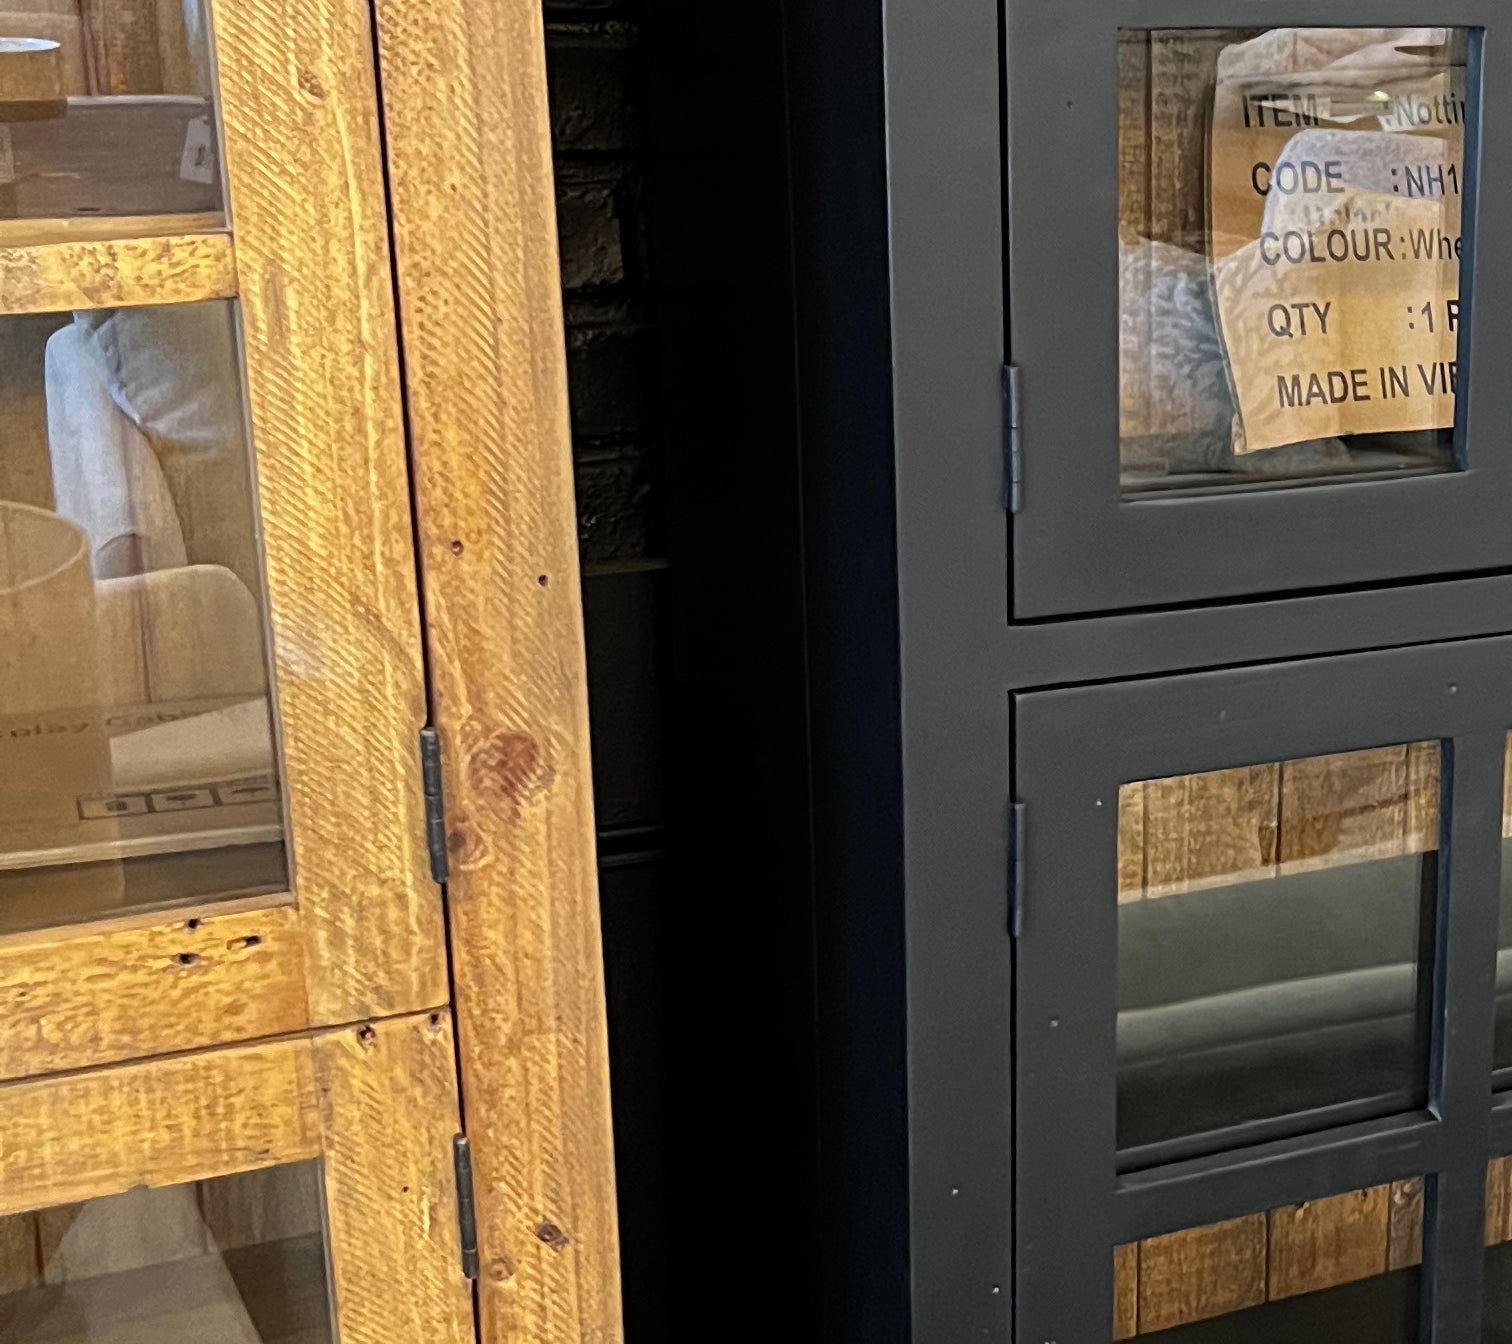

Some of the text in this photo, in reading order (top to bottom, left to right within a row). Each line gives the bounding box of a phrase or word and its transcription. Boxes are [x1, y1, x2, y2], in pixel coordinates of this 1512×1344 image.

[1241, 93, 1320, 129] ITEM
[1251, 160, 1346, 197] CODE
[1259, 227, 1396, 267] COLOUR
[1267, 301, 1332, 339] QTY
[1276, 368, 1371, 409] MADE
[1379, 364, 1410, 400] IN
